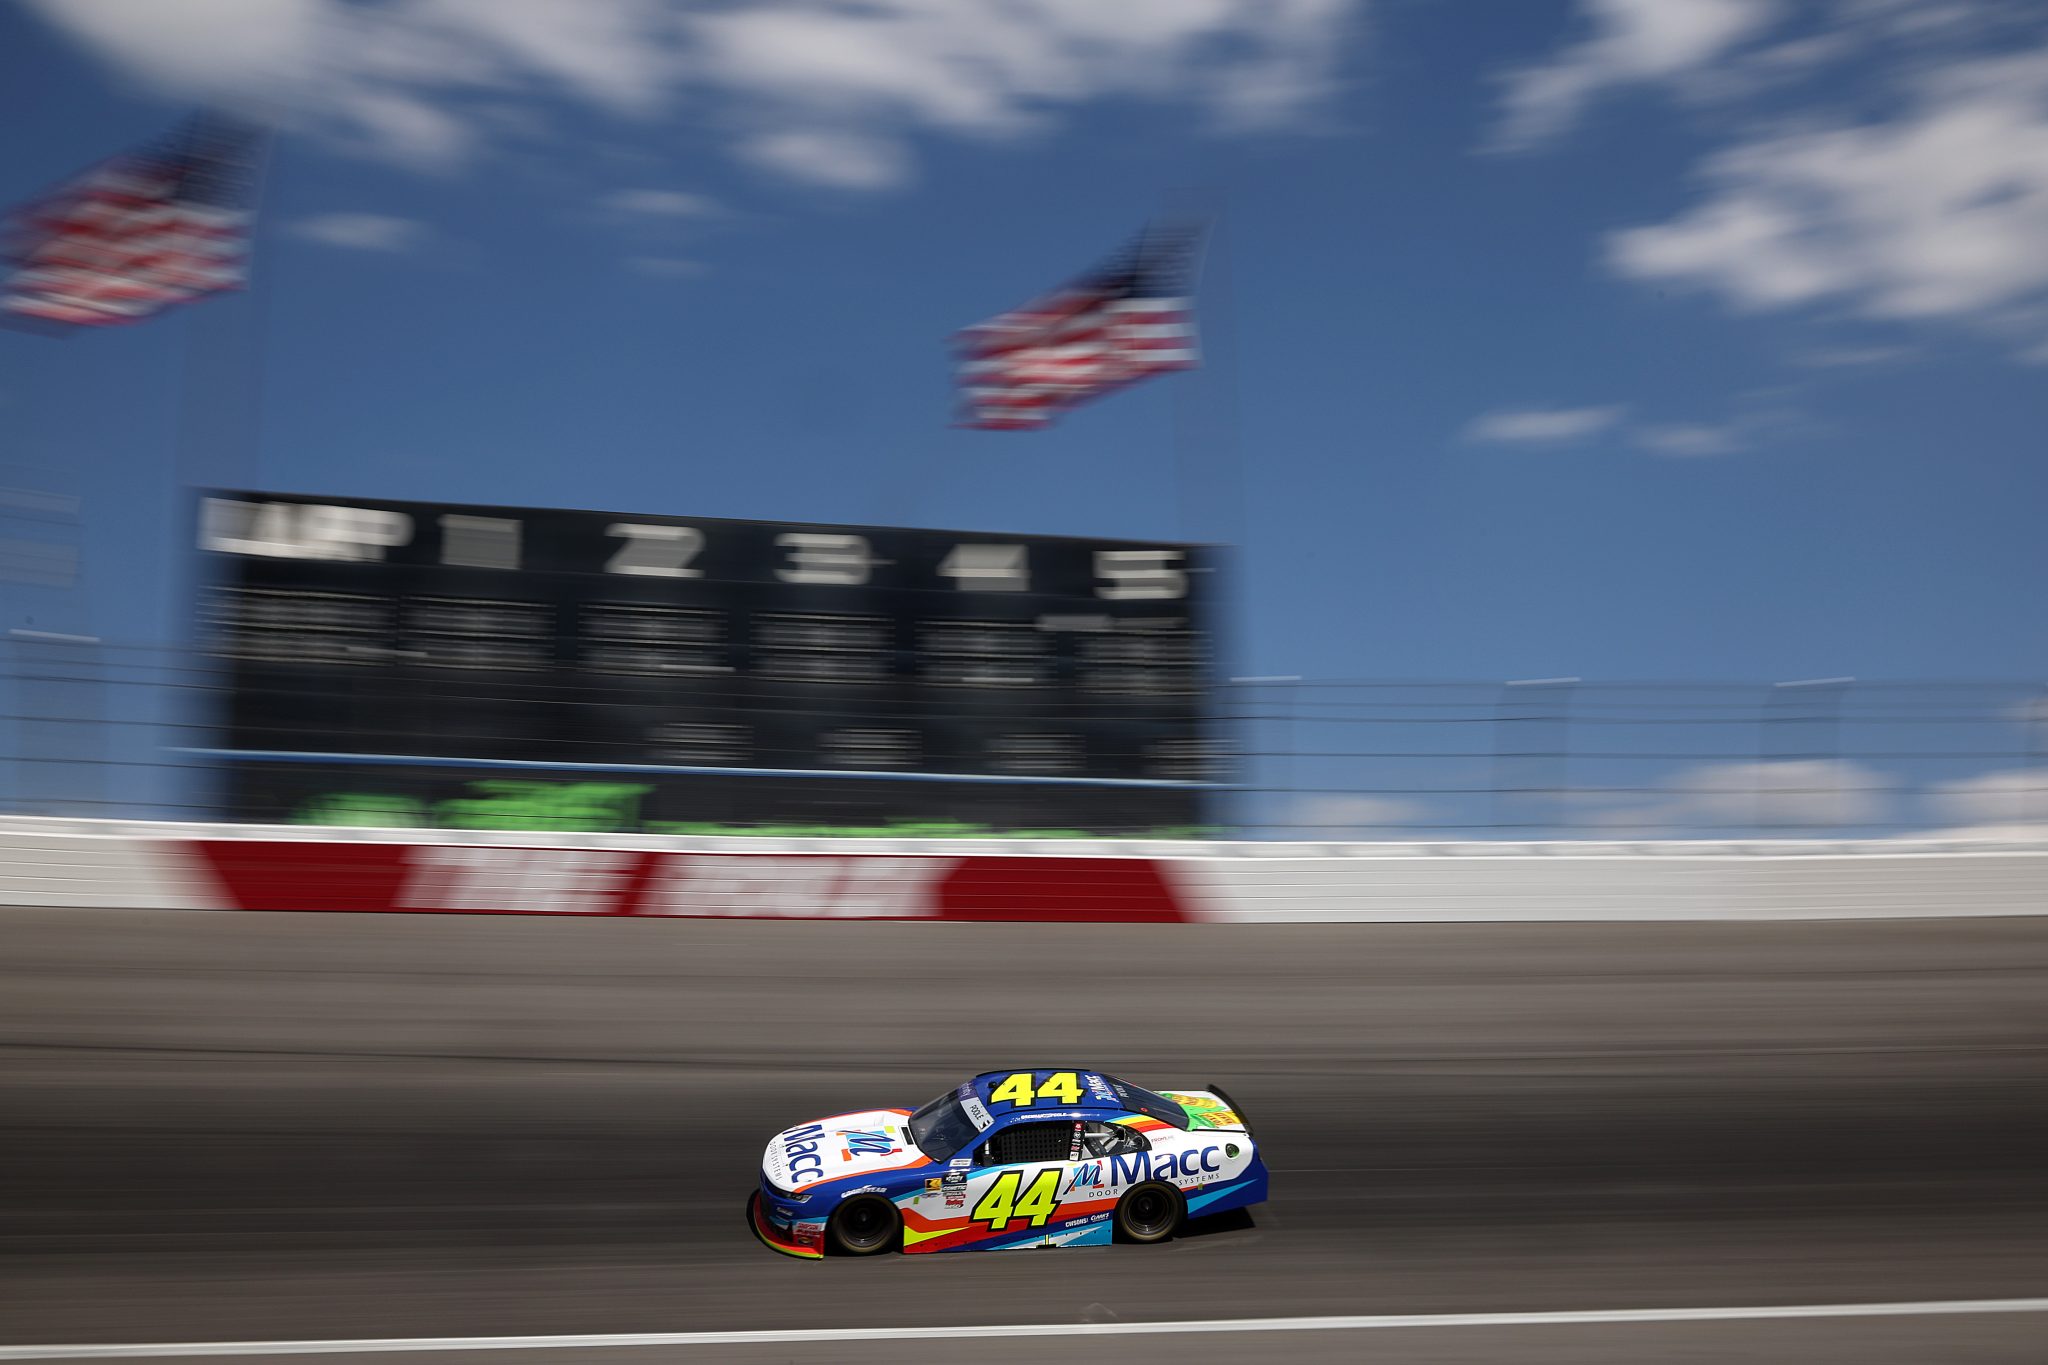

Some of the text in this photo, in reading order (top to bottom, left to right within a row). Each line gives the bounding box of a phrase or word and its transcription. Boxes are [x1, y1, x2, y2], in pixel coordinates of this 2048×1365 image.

[605, 522, 706, 578] 2
[774, 532, 872, 585] 3
[936, 543, 1031, 592] 4
[1093, 550, 1189, 600] 5
[988, 1071, 1084, 1105] 44
[970, 1104, 984, 1120] POOLE
[782, 1124, 825, 1184] Macc
[1110, 1145, 1220, 1187] Macc
[969, 1167, 1064, 1232] 44
[1088, 1172, 1220, 1198] DOOR SYSTEMS
